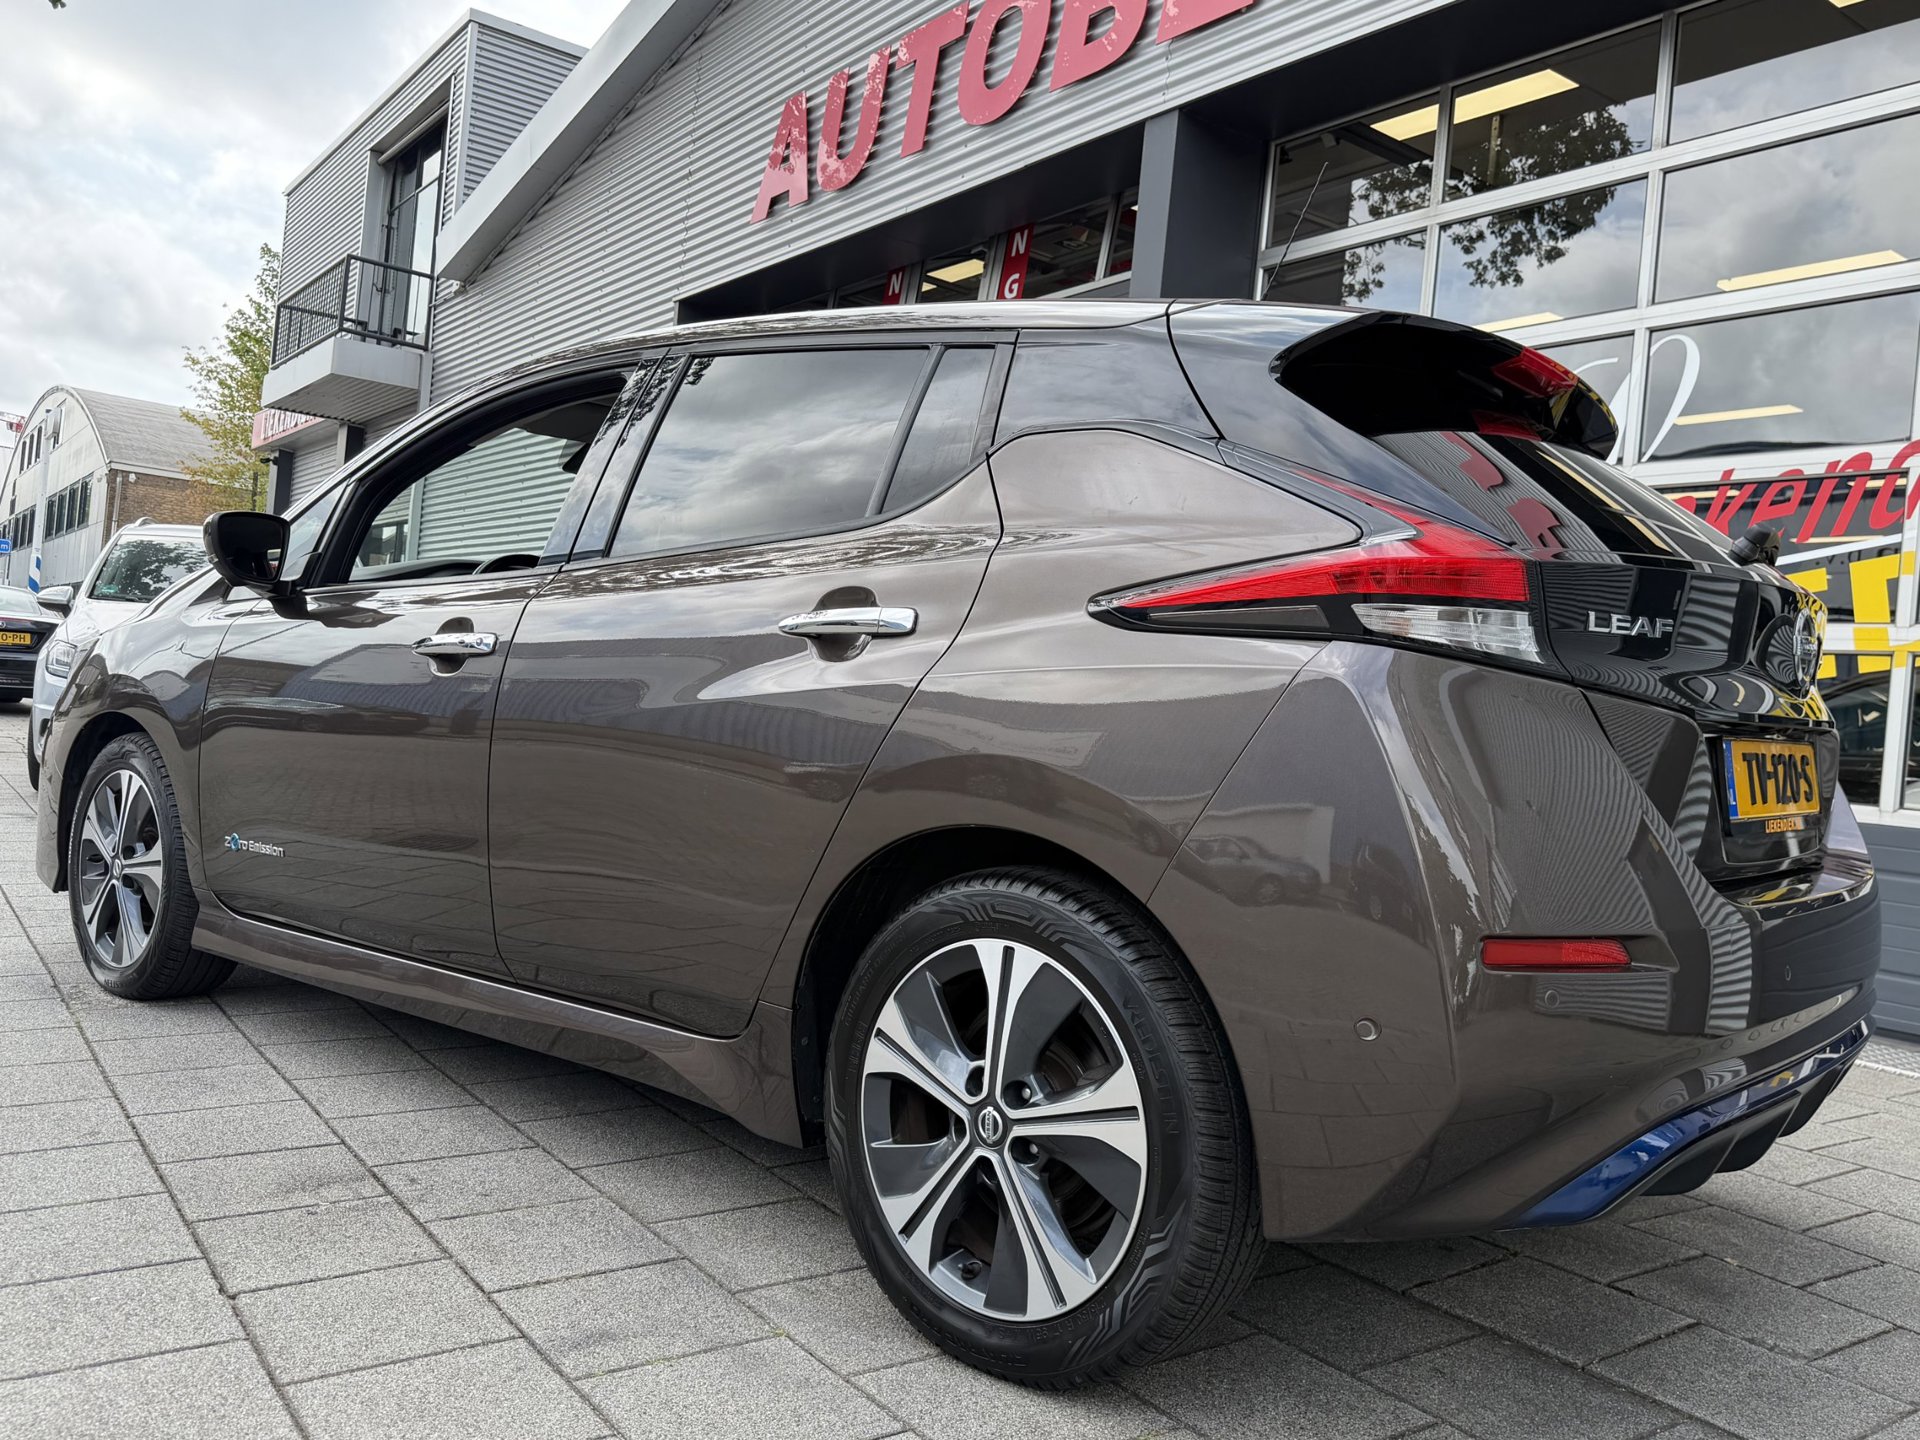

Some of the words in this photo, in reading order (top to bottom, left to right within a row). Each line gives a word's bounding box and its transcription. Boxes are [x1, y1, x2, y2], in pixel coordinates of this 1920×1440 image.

[750, 0, 1254, 225] AUTOB
[1587, 610, 1675, 639] LEAF
[248, 840, 284, 858] Emission
